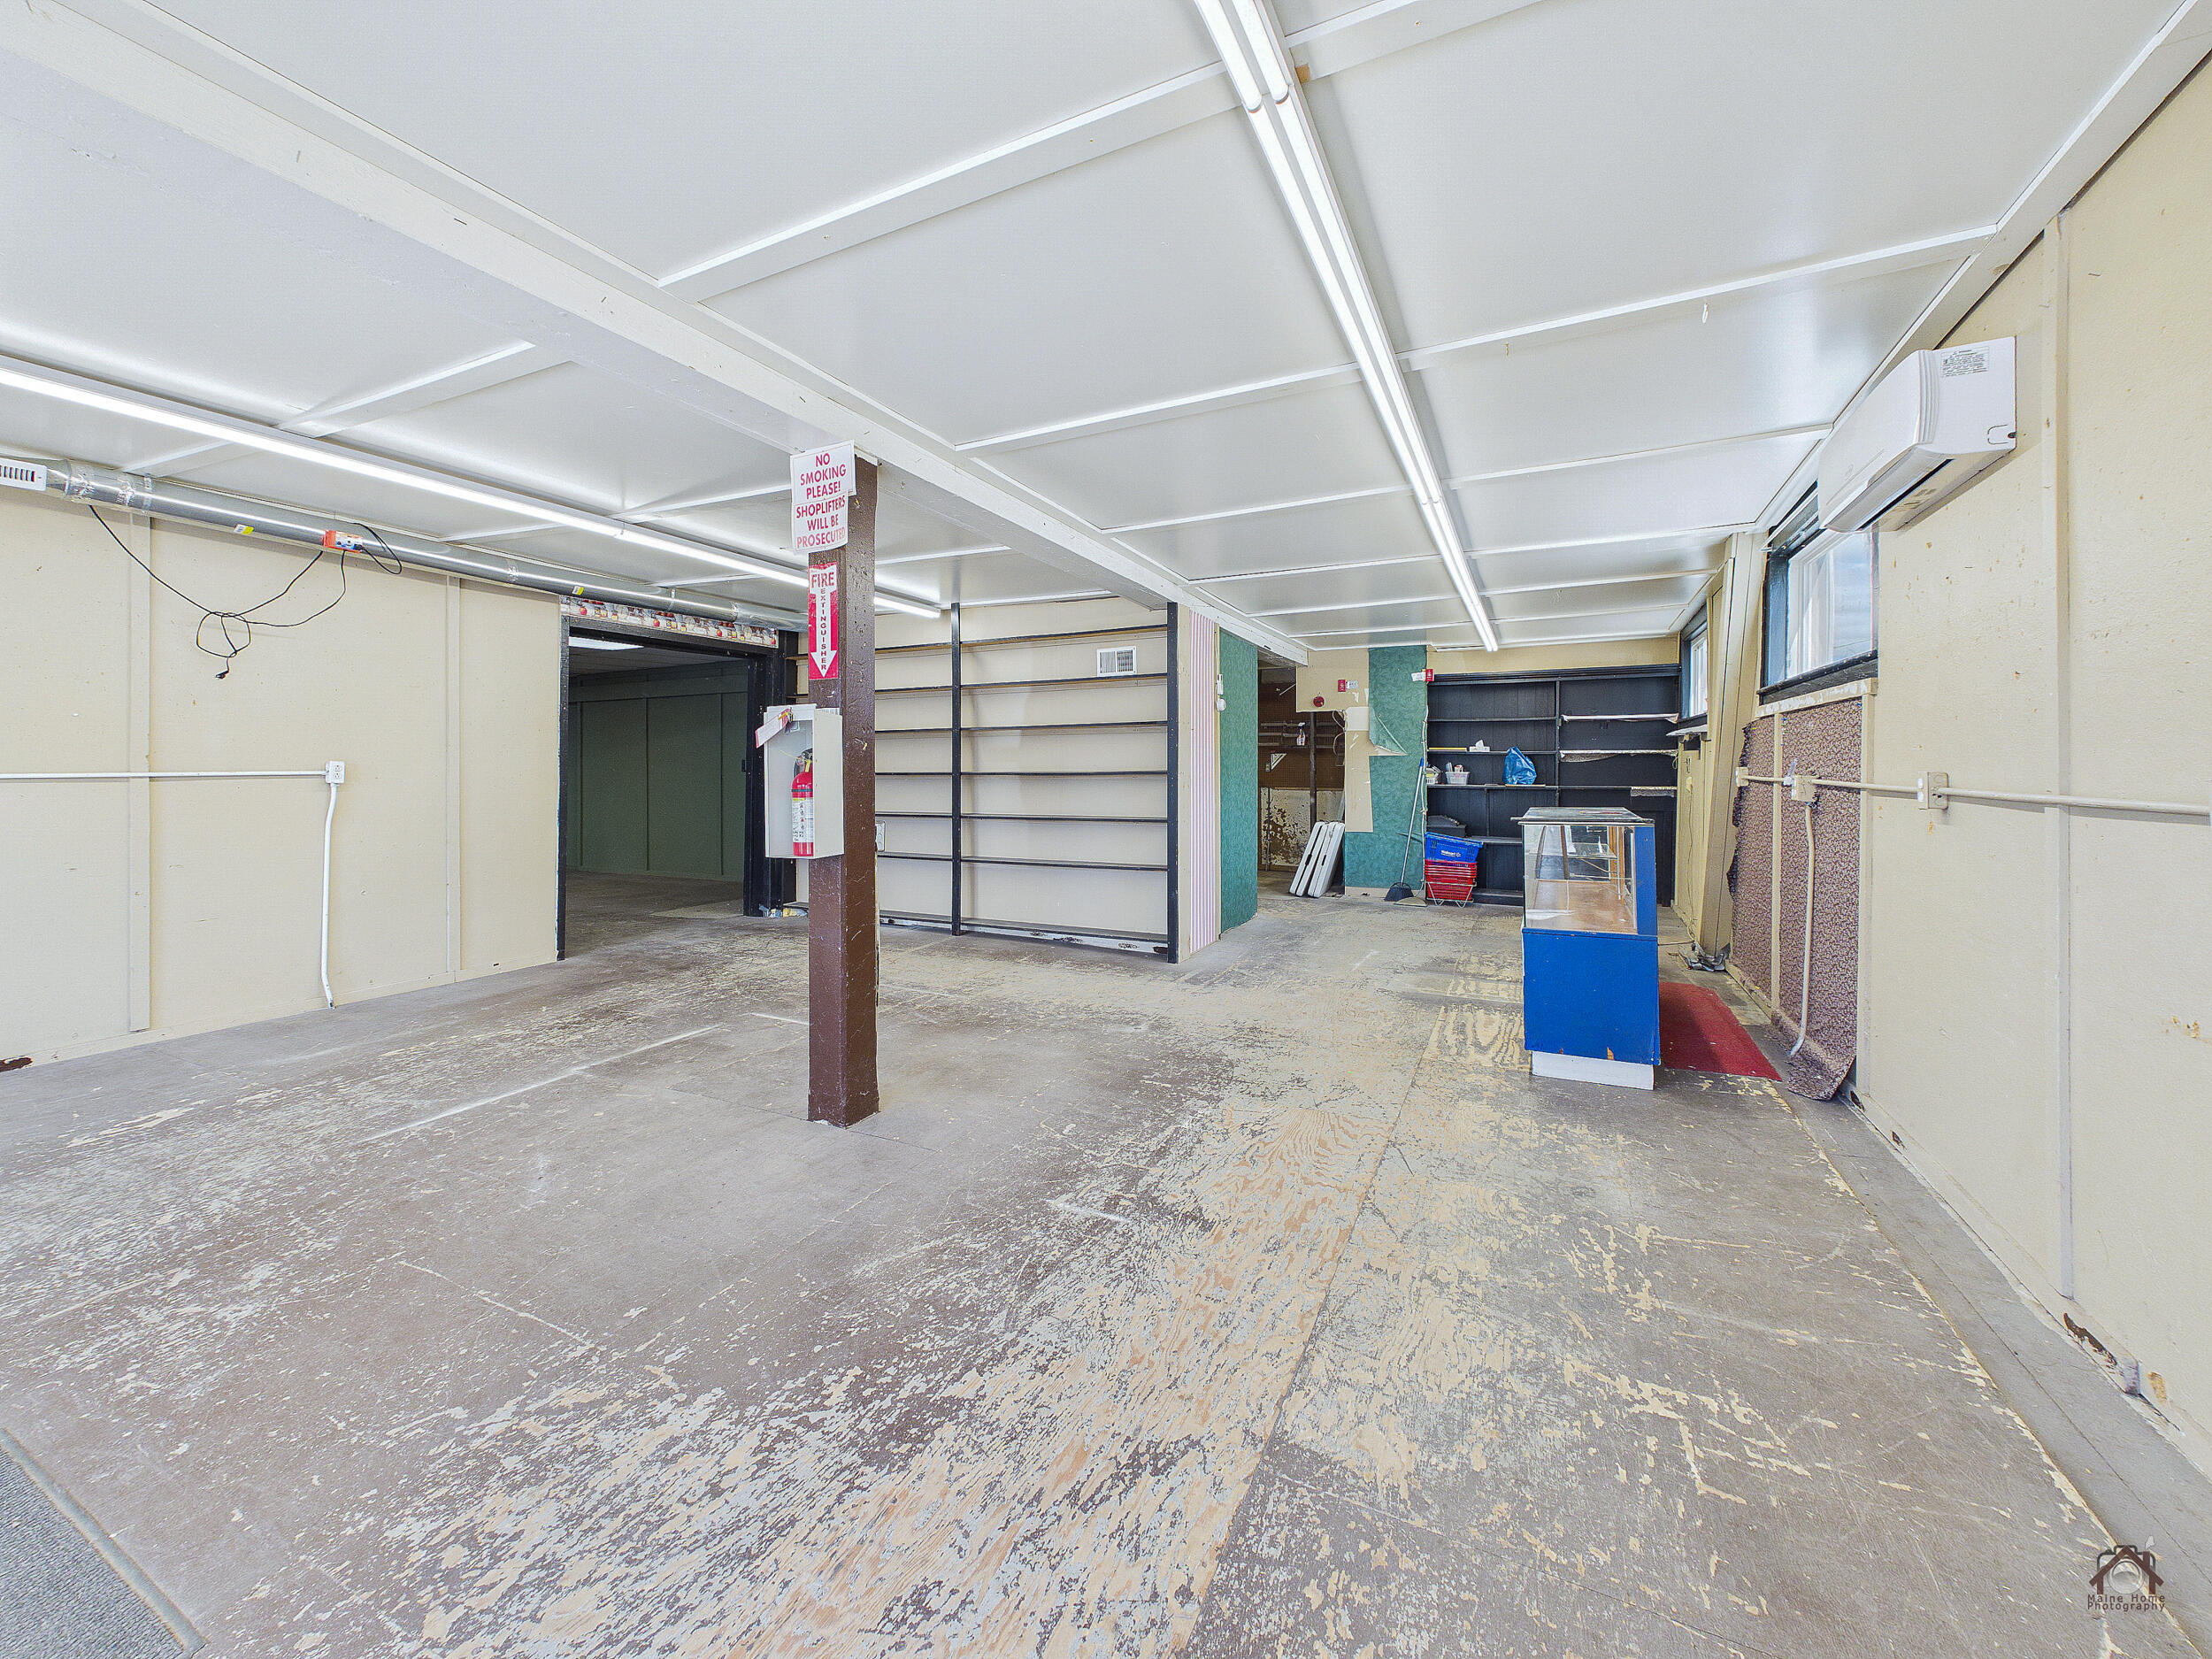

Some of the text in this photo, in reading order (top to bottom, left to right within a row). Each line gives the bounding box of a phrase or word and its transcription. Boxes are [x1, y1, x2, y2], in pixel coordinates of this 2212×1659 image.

[816, 453, 830, 467] NO
[801, 465, 846, 486] SMOKING
[807, 481, 841, 499] PLEASE!
[796, 495, 845, 518] SHOPLIFTERS
[807, 513, 839, 531] WILL BE
[797, 527, 845, 549] PROSECUTED
[811, 572, 834, 588] FIRE
